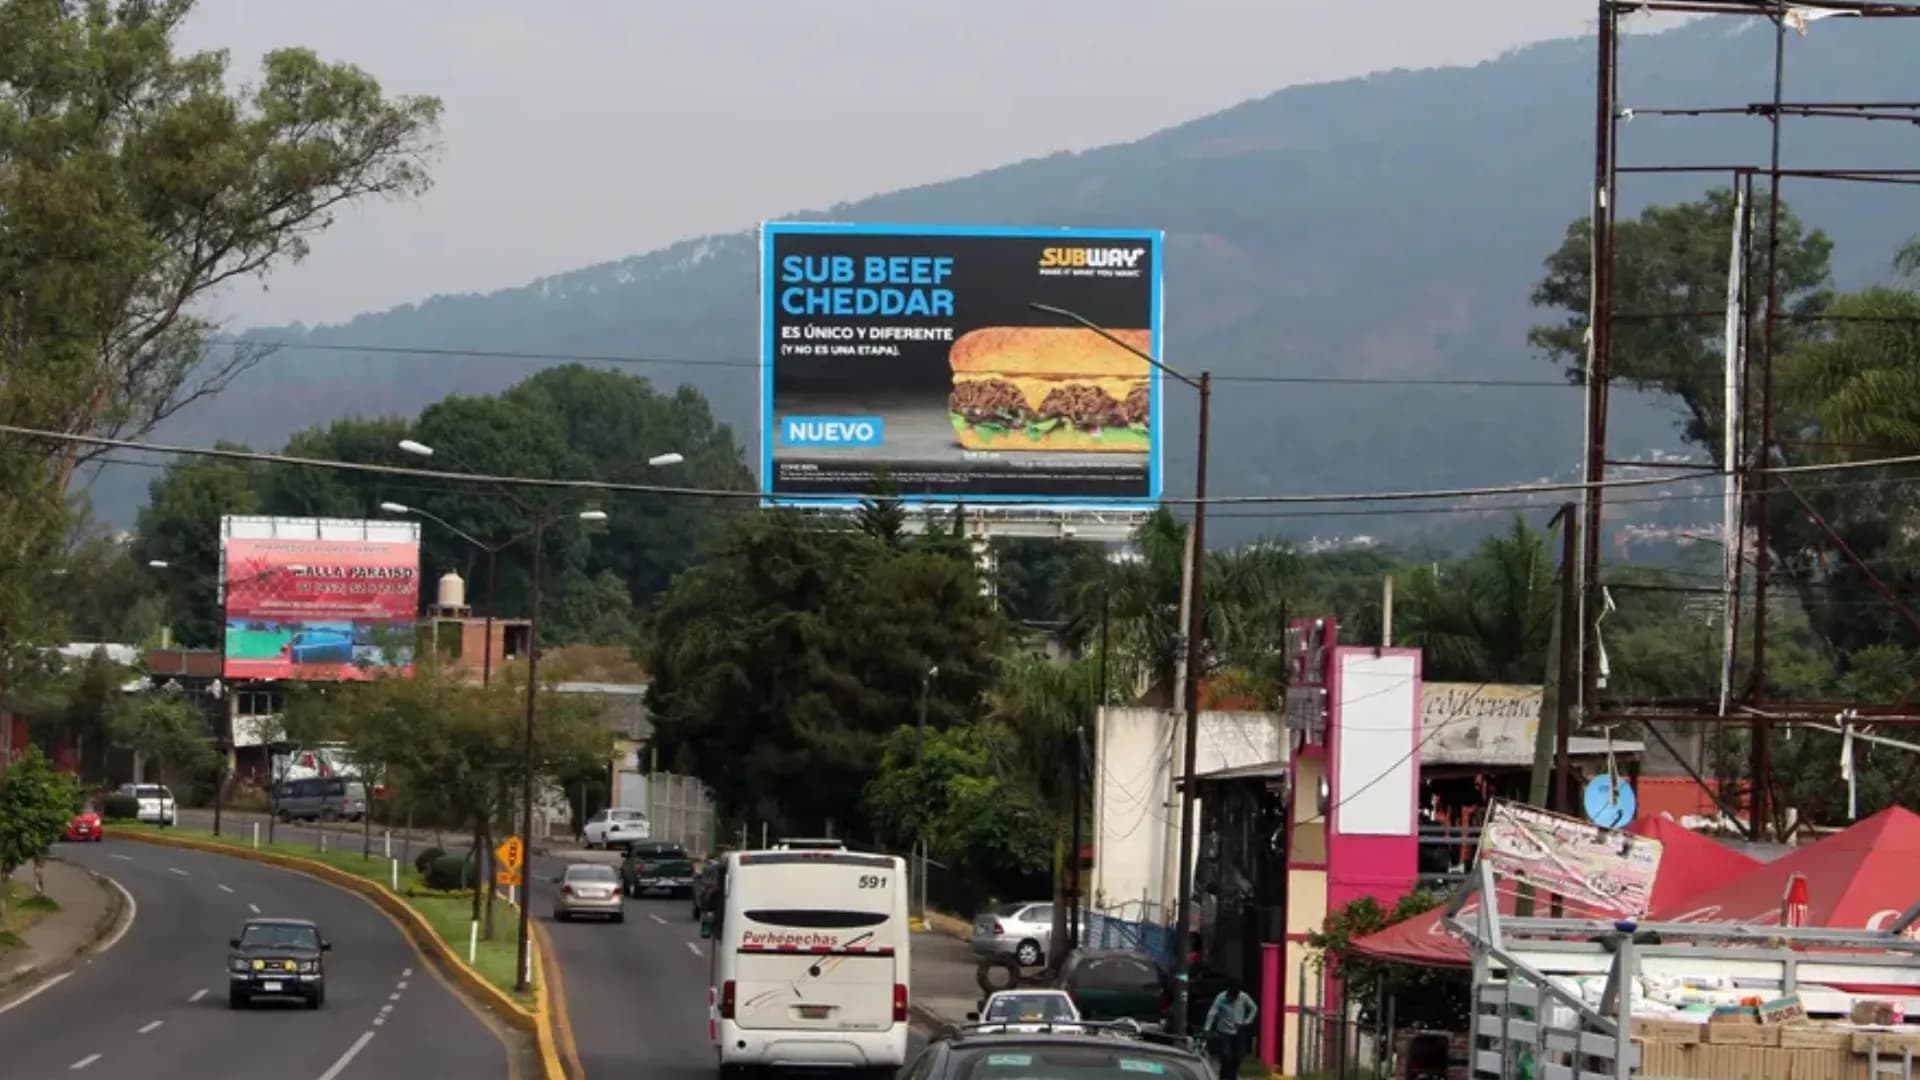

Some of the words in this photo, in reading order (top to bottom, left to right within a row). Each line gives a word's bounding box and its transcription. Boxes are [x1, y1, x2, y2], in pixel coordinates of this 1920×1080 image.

[1039, 248, 1145, 268] SUBWAY
[782, 255, 856, 283] SUB
[864, 256, 954, 284] BEEF
[781, 287, 954, 316] CHEDDAR
[782, 326, 800, 339] ES
[804, 323, 854, 339] ÚNICO
[856, 327, 867, 340] Y
[869, 328, 953, 341] DIFERENTE
[795, 344, 812, 354] NO
[815, 344, 829, 354] ES
[831, 344, 856, 355] UNA
[789, 422, 874, 441] NUEVO
[858, 876, 887, 889] 591
